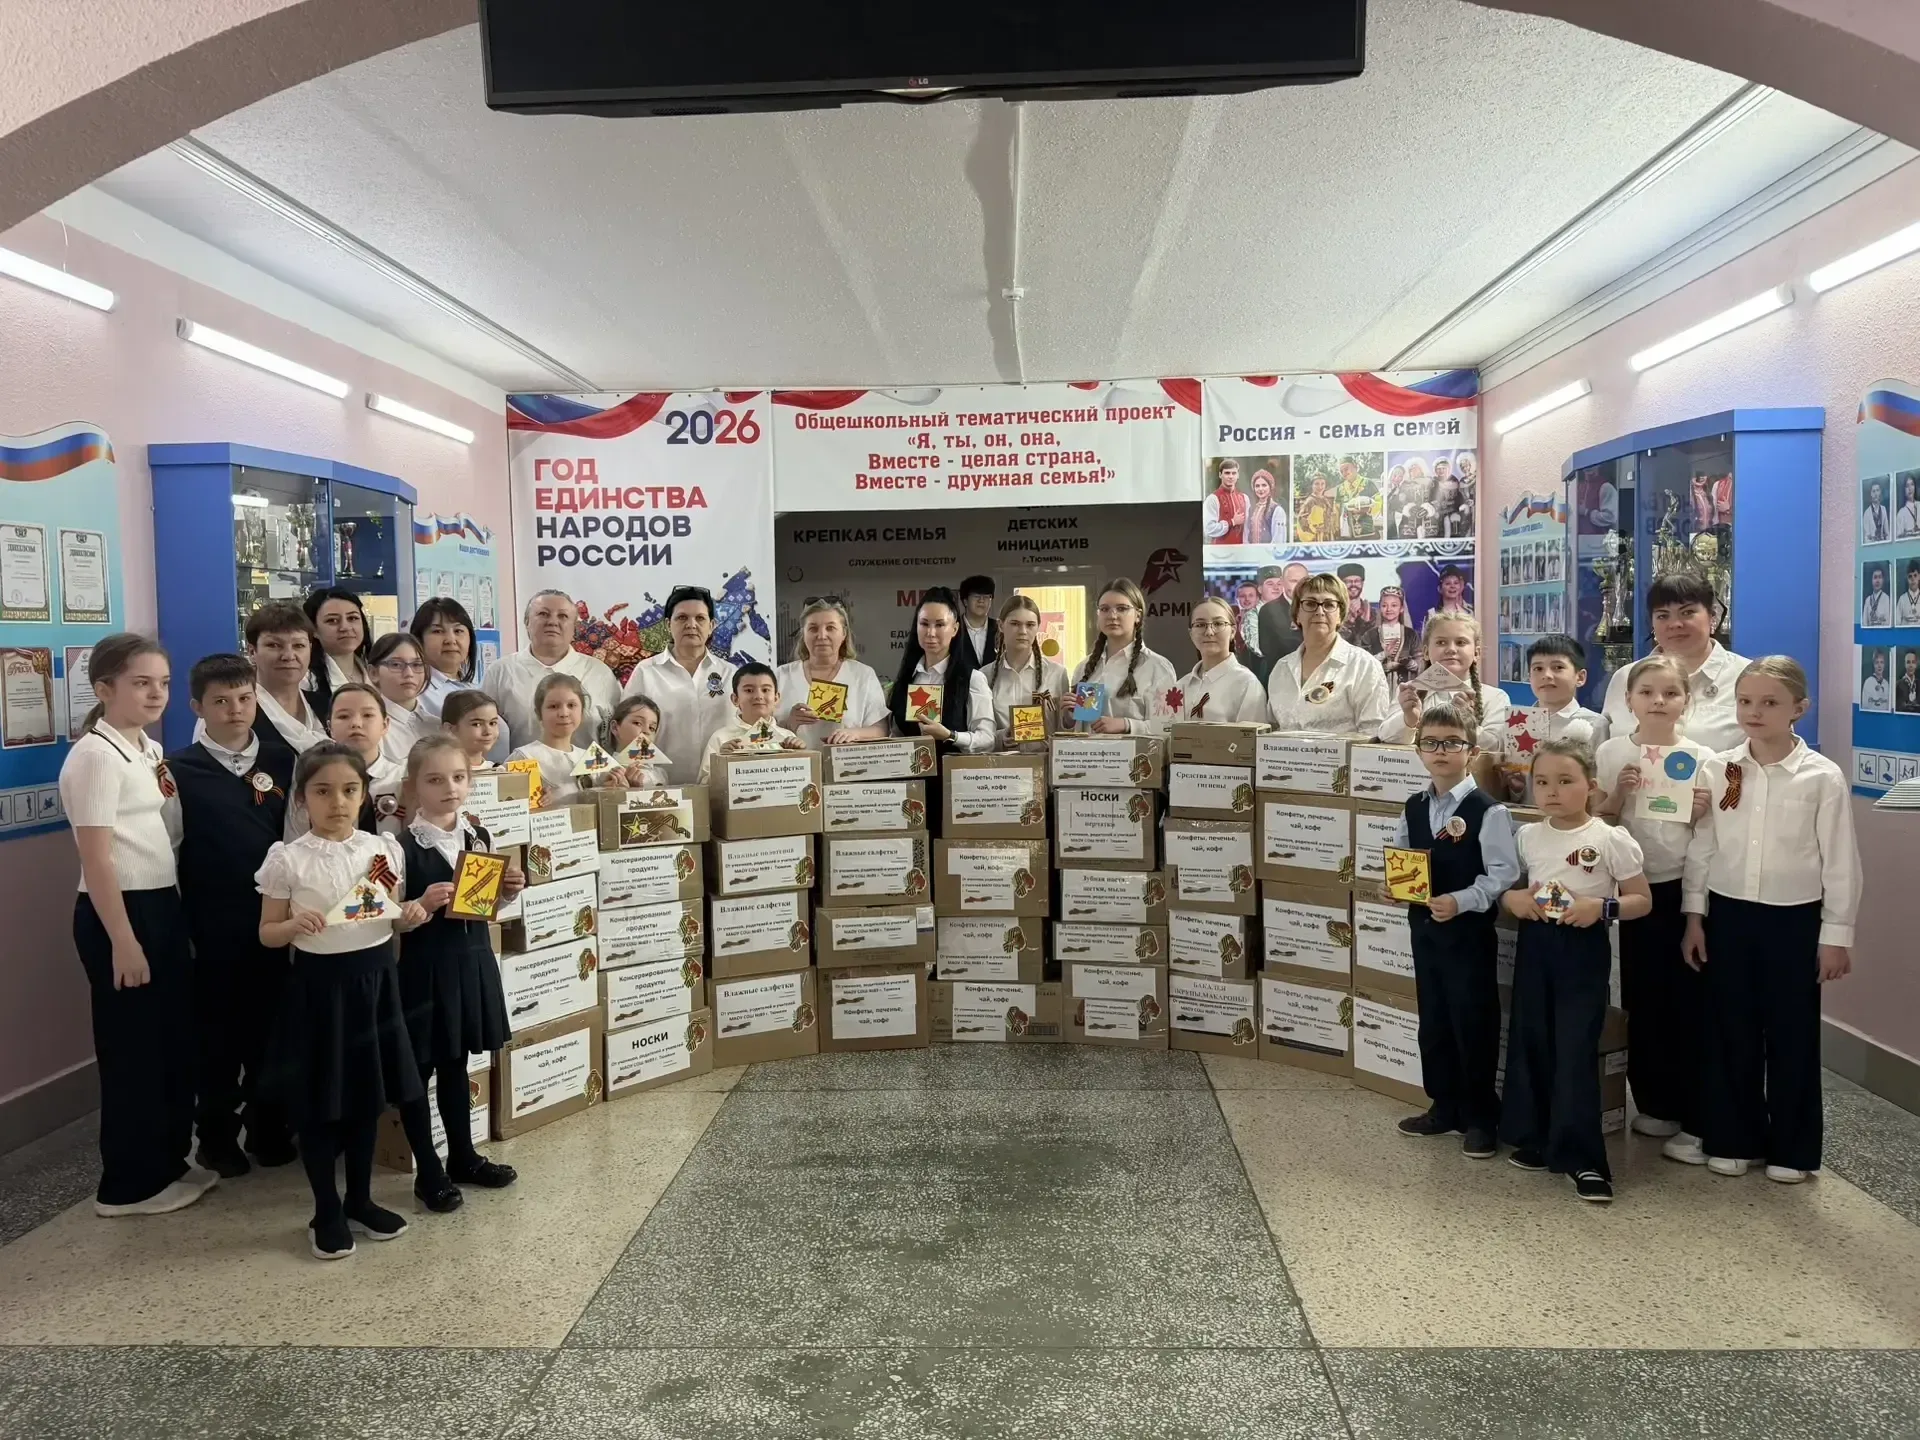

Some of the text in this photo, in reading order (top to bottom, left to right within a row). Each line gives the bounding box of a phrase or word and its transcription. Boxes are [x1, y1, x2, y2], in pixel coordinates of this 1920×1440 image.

[665, 409, 761, 445] 2026
[795, 405, 1176, 431] Общешкольный тематический проект
[908, 431, 1061, 449] «Я, ты, он, она,
[1219, 425, 1295, 443] Россия
[1319, 423, 1385, 439] семья
[1393, 418, 1461, 437] семей
[868, 453, 940, 470] Вместе
[961, 453, 1018, 469] целая
[1026, 450, 1101, 468] страна,
[534, 458, 598, 484] ГОД
[855, 473, 927, 490] Вместе
[947, 472, 1033, 491] дружная
[1040, 466, 1115, 485] семья!»
[535, 486, 708, 513] ЕДИНСТВА
[536, 515, 692, 541] НАРОДОВ
[1007, 517, 1078, 532] ДЕТСКИХ
[793, 527, 947, 543] КРЕПКАЯ СЕМЬЯ
[997, 538, 1089, 552] ИНИЦИАТИВ
[537, 544, 672, 567] РОССИИ
[848, 557, 956, 567] СЛУЖЕНИЕ ОТЕЧЕСТВУ
[1080, 791, 1120, 802] Носки
[1276, 810, 1337, 822] Конфеты, печенье,
[1290, 822, 1304, 830] чай,
[723, 982, 795, 998] Влажные салфетки
[631, 1031, 669, 1050] НОСКИ
[1363, 1038, 1419, 1059] Конфеты, печенье,
[523, 1040, 580, 1061] Конфеты, печенье,
[551, 1055, 567, 1066] кофе
[1389, 1057, 1405, 1067] кофе
